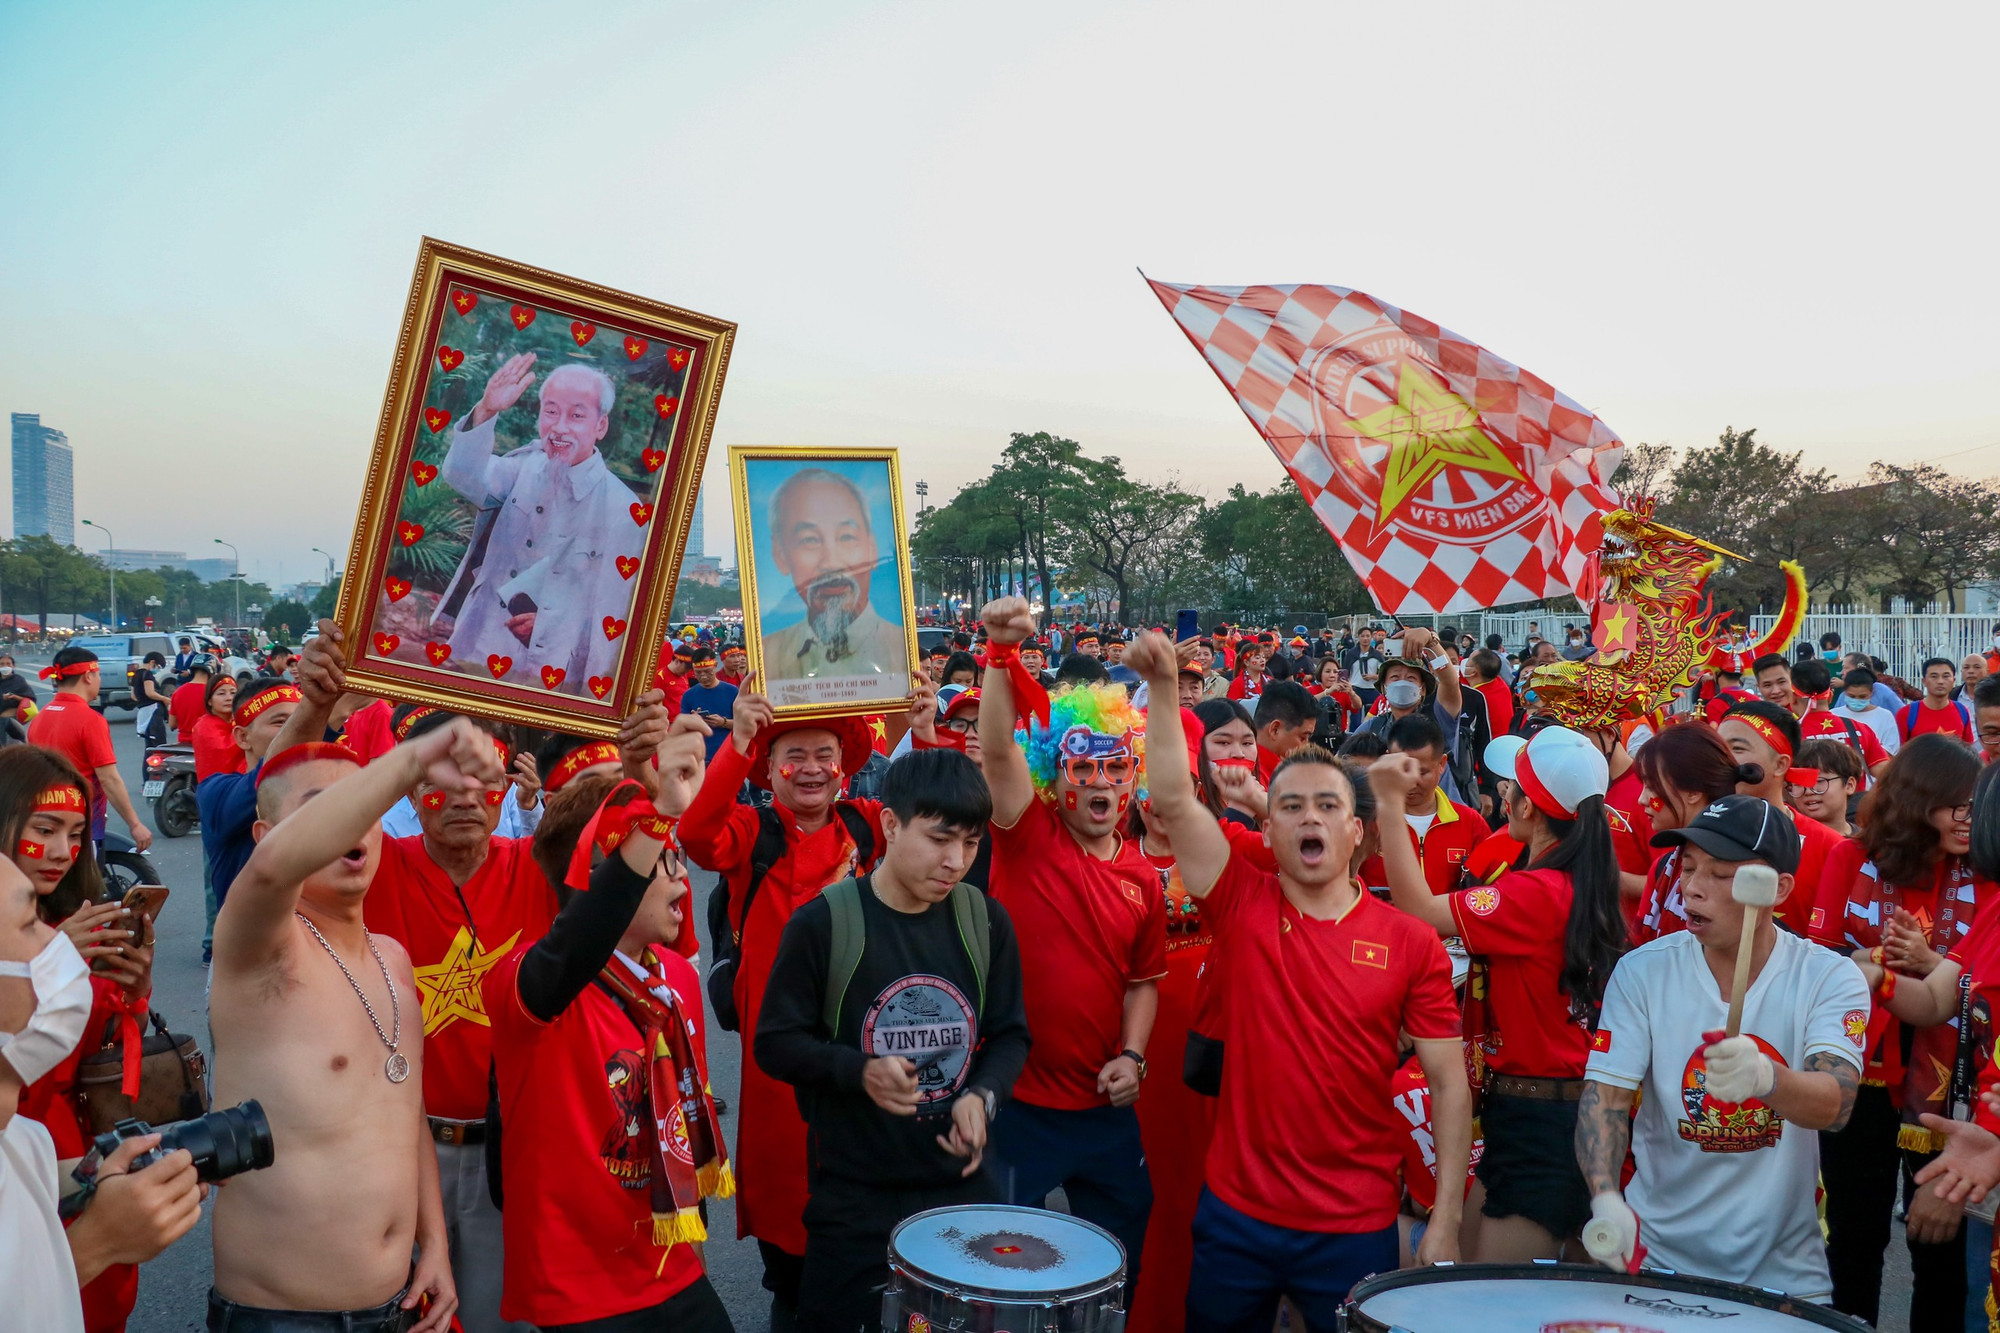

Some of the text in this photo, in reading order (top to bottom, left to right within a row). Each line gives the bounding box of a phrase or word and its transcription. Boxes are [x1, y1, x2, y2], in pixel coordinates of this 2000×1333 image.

[1361, 338, 1424, 361] SUPPO
[1410, 506, 1450, 528] VFS
[1453, 508, 1508, 530] MIEN
[261, 690, 280, 705] NAM
[36, 789, 66, 805] NAM
[882, 1027, 962, 1050] VINTAGE
